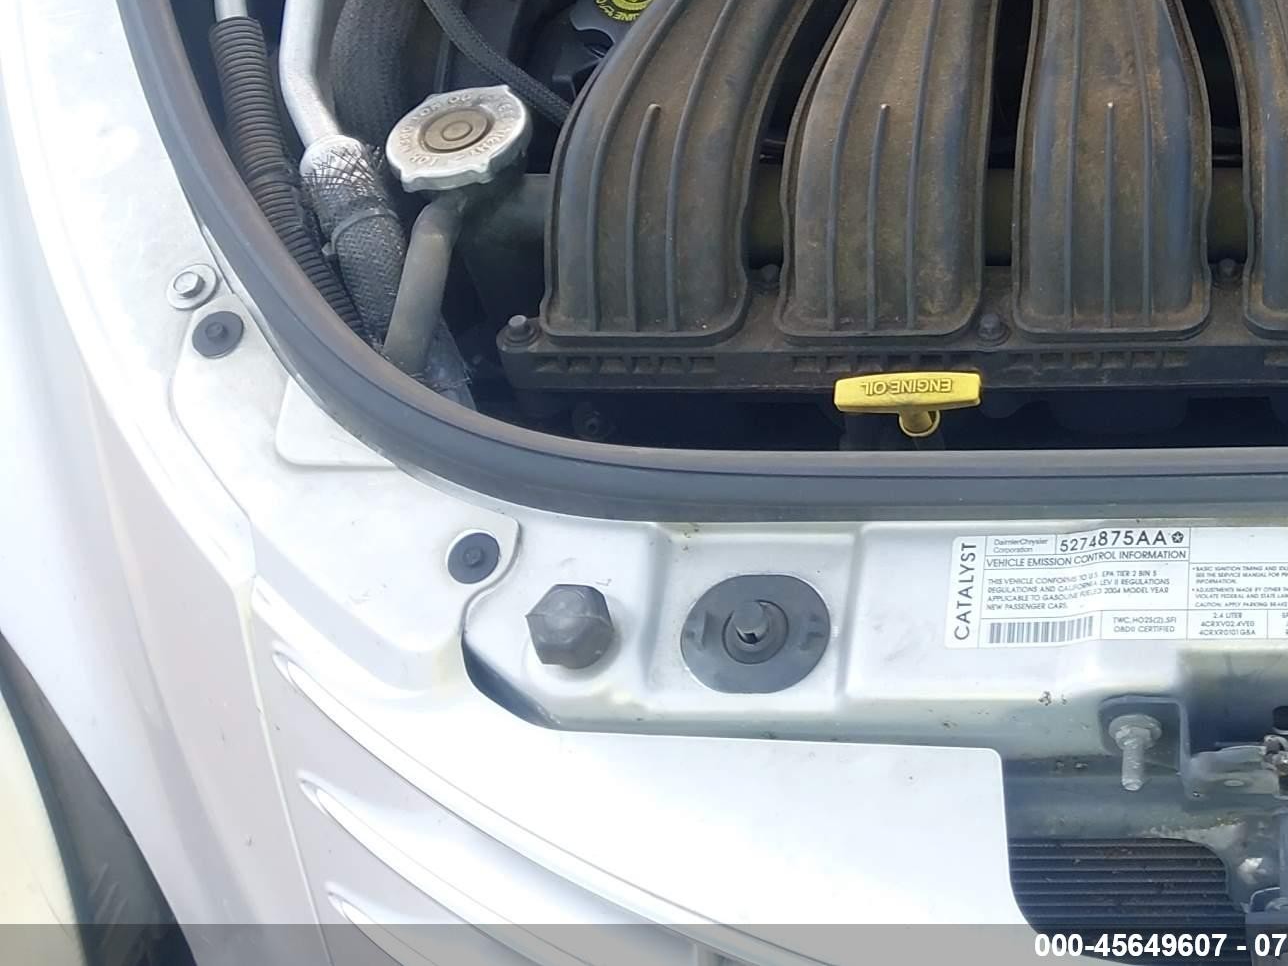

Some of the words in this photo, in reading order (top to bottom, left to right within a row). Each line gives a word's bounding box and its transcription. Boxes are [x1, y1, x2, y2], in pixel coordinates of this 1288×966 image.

[862, 380, 887, 395] OIL
[890, 378, 953, 394] ENGINE
[1060, 530, 1167, 552] 5274875AA
[987, 558, 1025, 567] VEHICLE
[1027, 557, 1072, 566] EMISSION
[1074, 551, 1116, 565] CONTROL
[1119, 550, 1186, 559] INFORMATION
[954, 542, 976, 640] CATALYST
